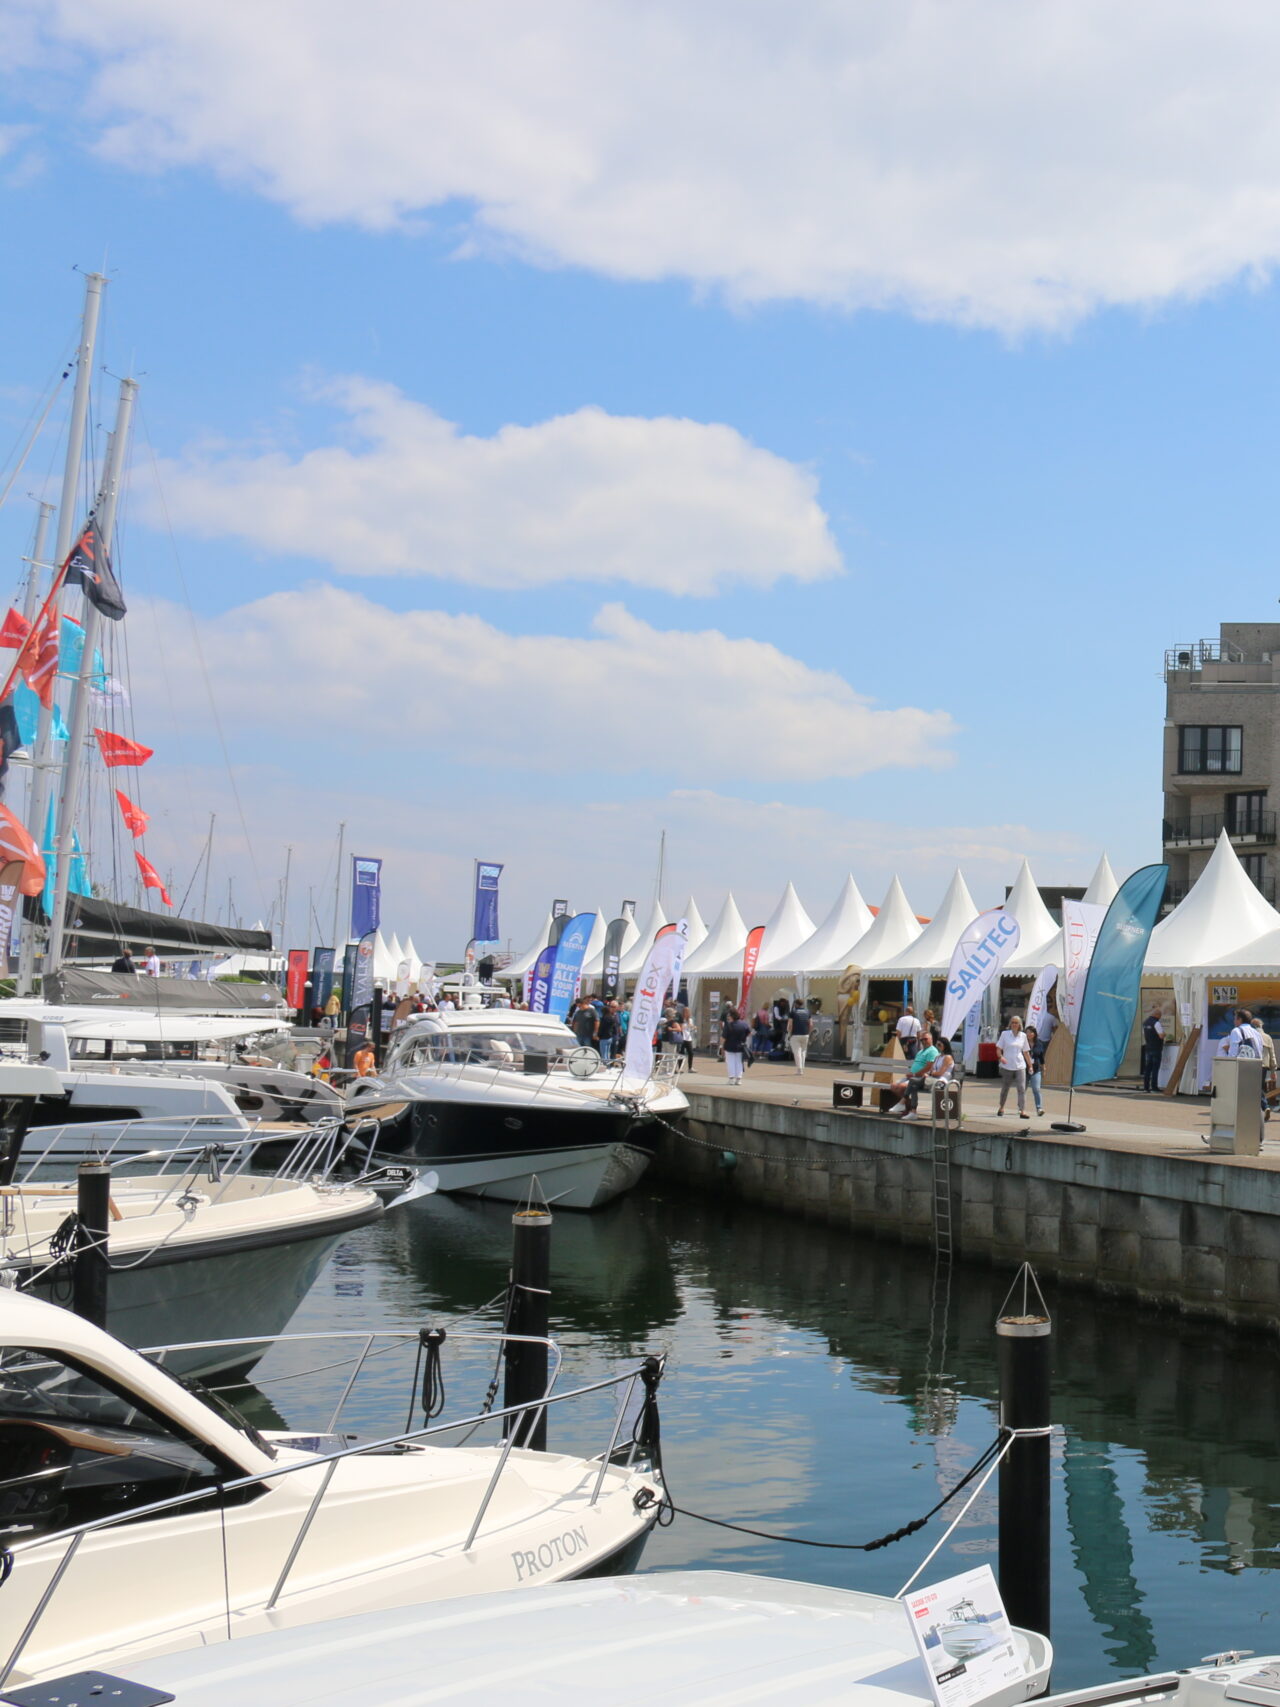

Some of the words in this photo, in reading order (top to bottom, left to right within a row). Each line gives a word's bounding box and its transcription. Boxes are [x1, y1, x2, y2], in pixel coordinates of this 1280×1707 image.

[948, 916, 1017, 1001] SAILTEC
[554, 970, 574, 982] ALL
[386, 1169, 404, 1177] DELTA
[511, 1525, 589, 1582] PROTON
